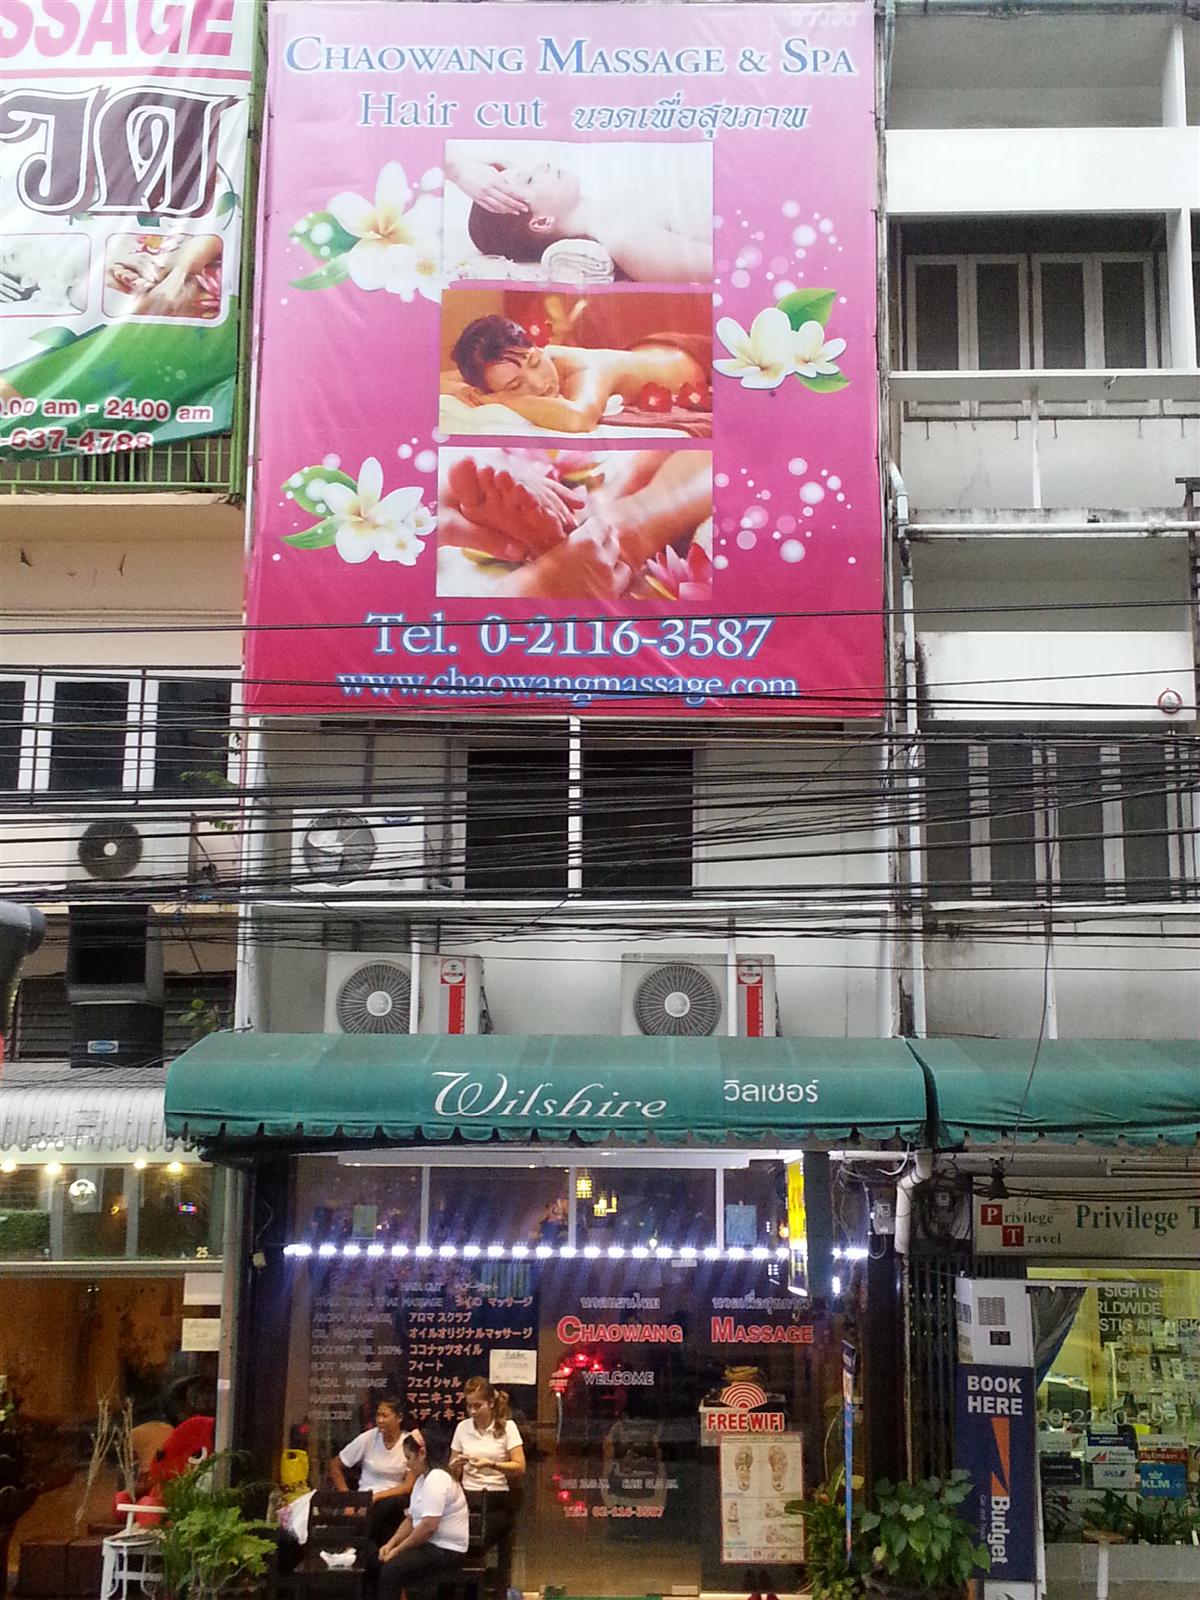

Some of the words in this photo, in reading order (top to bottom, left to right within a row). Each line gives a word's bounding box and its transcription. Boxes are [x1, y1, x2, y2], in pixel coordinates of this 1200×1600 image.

[285, 36, 524, 76] CHAOWANG
[538, 36, 725, 75] MASSAGE
[738, 46, 768, 74] &
[783, 36, 856, 76] SPA
[359, 92, 458, 130] Hair
[476, 96, 545, 129] cut
[573, 92, 810, 141] นวดเพื่อสุขภาพ
[0, 398, 36, 416] .00
[43, 399, 78, 415] am
[106, 398, 169, 419] 24.00
[177, 405, 212, 420] am
[366, 612, 457, 655] Tel.
[479, 615, 776, 660] 0-2116-3587
[336, 667, 799, 706] www.chaowangmassage.com
[432, 1071, 667, 1119] Wilshire
[1076, 1204, 1180, 1237] Privilege
[409, 1312, 436, 1323] アロマ
[557, 1316, 683, 1344] CHAOWANG
[711, 1316, 814, 1343] MASSAGE
[408, 1361, 444, 1371] フィート
[582, 1371, 655, 1386] WELCOME
[407, 1377, 462, 1388] フェイシャル
[967, 1375, 1022, 1393] BOOK
[967, 1395, 1023, 1415] HERE
[707, 1414, 749, 1430] FREE
[750, 1414, 785, 1431] WIFI
[1141, 1479, 1170, 1489] KLM
[988, 1496, 1010, 1563] Budget
